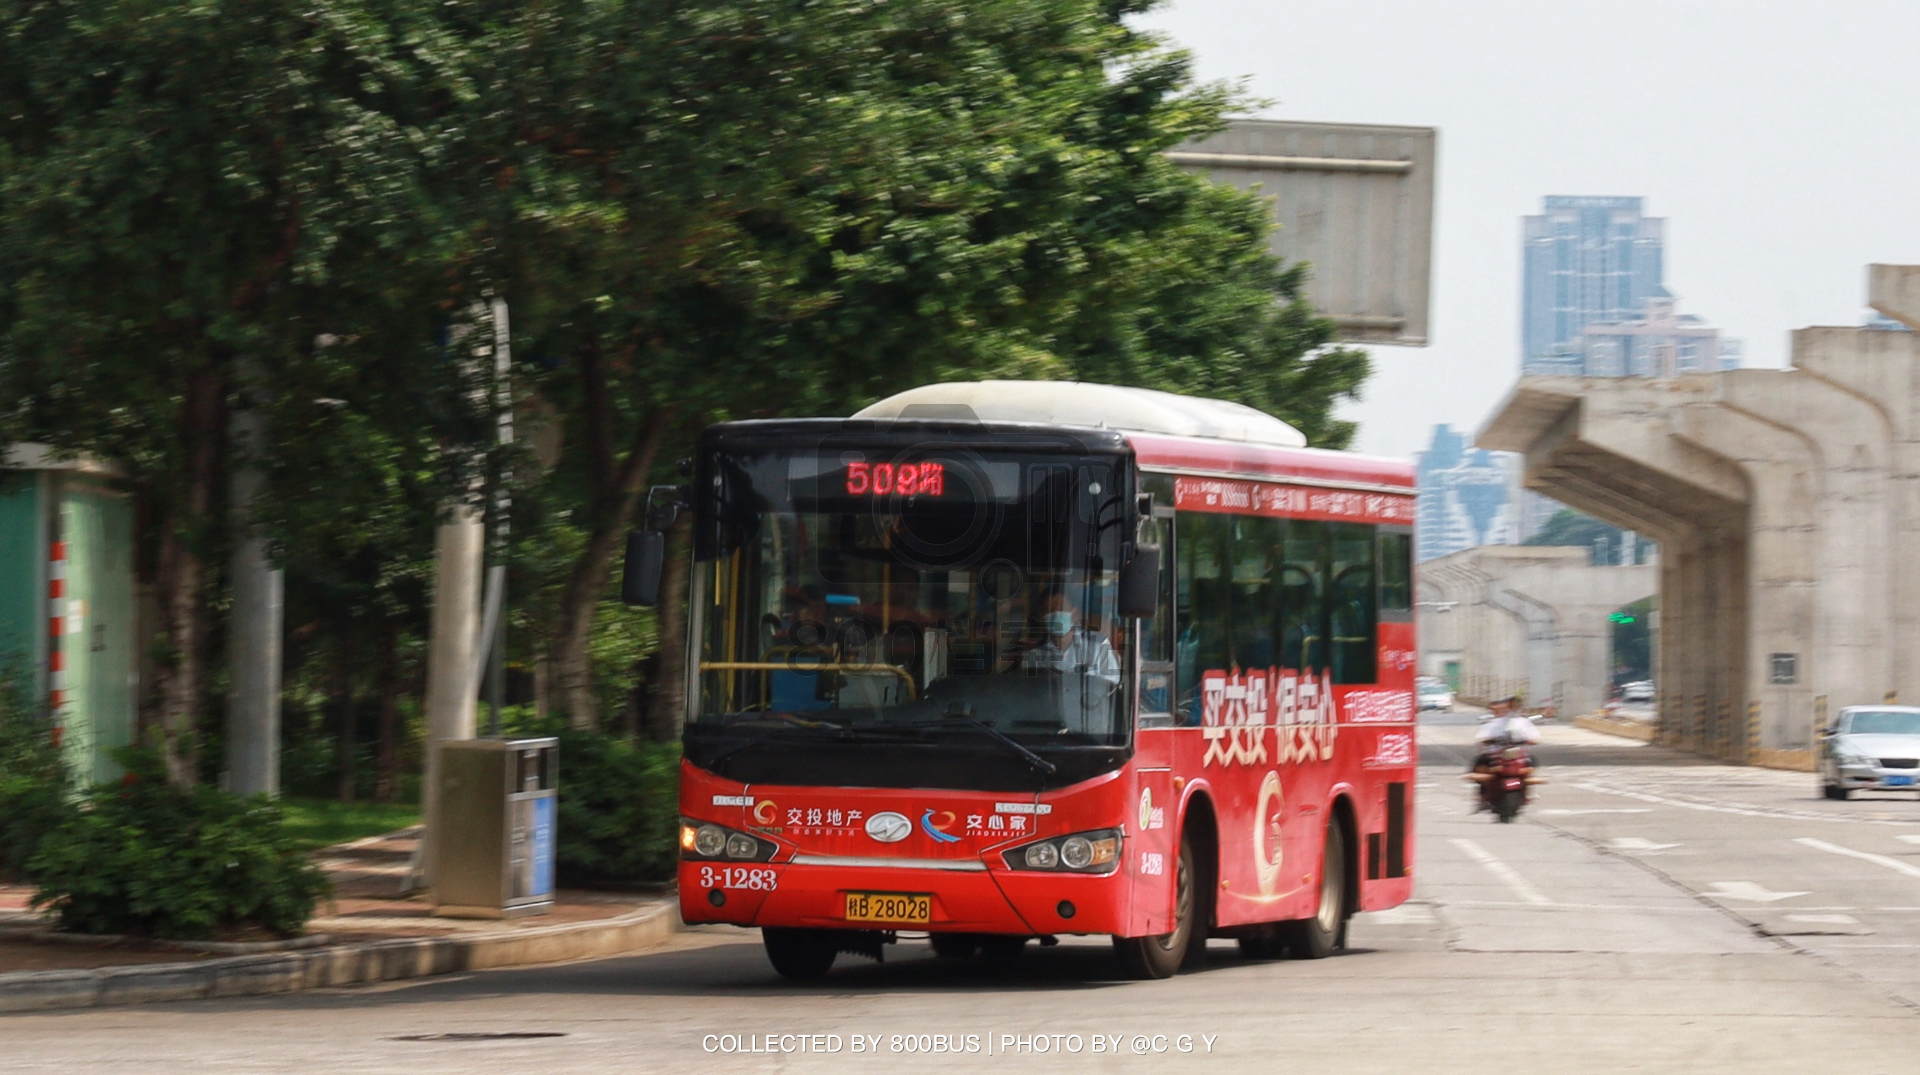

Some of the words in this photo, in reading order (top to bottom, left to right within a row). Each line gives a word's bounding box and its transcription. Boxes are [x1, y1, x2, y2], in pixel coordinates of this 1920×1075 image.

[846, 462, 944, 496] 509路
[786, 807, 863, 827] 交投地产
[966, 814, 1027, 831] 交心家
[700, 866, 778, 892] 3-1283
